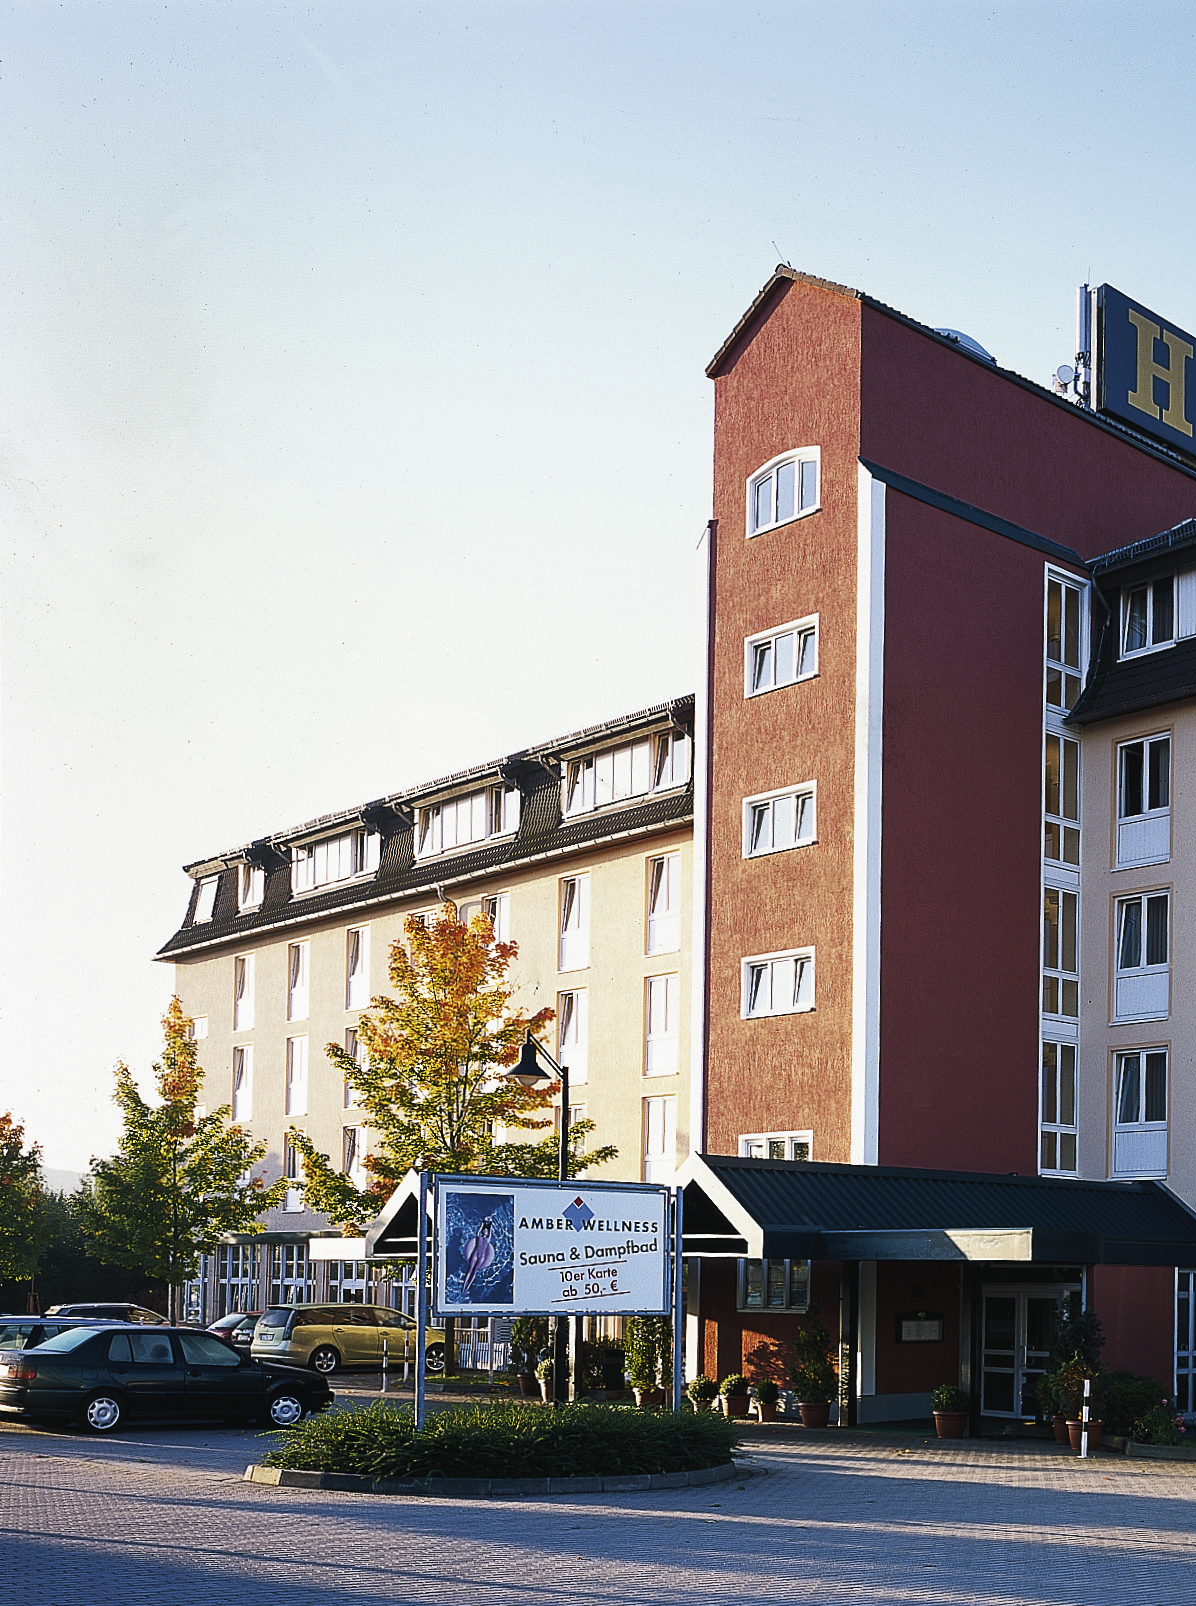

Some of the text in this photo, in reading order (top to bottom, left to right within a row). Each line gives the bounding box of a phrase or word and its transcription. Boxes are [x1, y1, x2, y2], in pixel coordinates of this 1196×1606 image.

[519, 1217, 658, 1233] AMBER WELLNESS
[519, 1237, 658, 1266] Sauna & Dampfbad
[560, 1267, 618, 1282] 10er Karte
[562, 1279, 618, 1297] ab 50,- €
